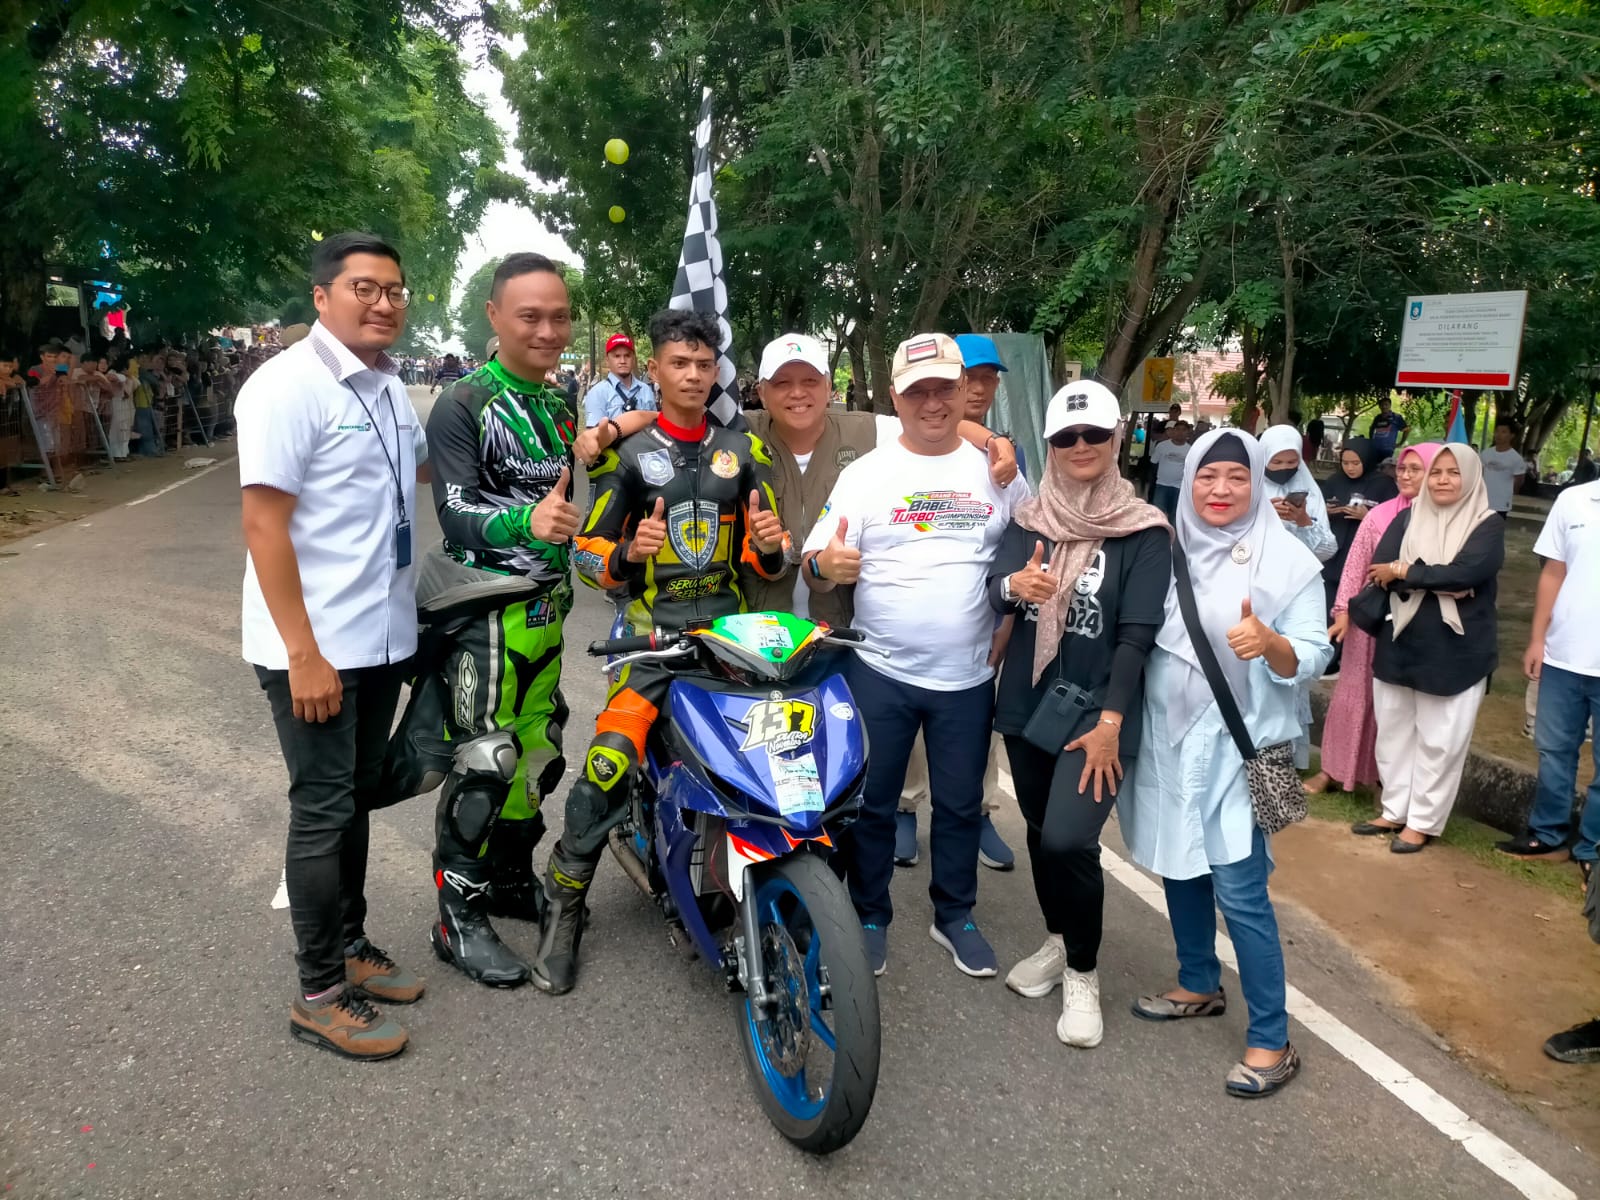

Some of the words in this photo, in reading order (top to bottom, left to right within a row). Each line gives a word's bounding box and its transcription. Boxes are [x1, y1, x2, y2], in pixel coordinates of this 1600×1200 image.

[908, 500, 953, 511] BABEL
[892, 509, 935, 522] TURBO
[1065, 605, 1100, 634] 024
